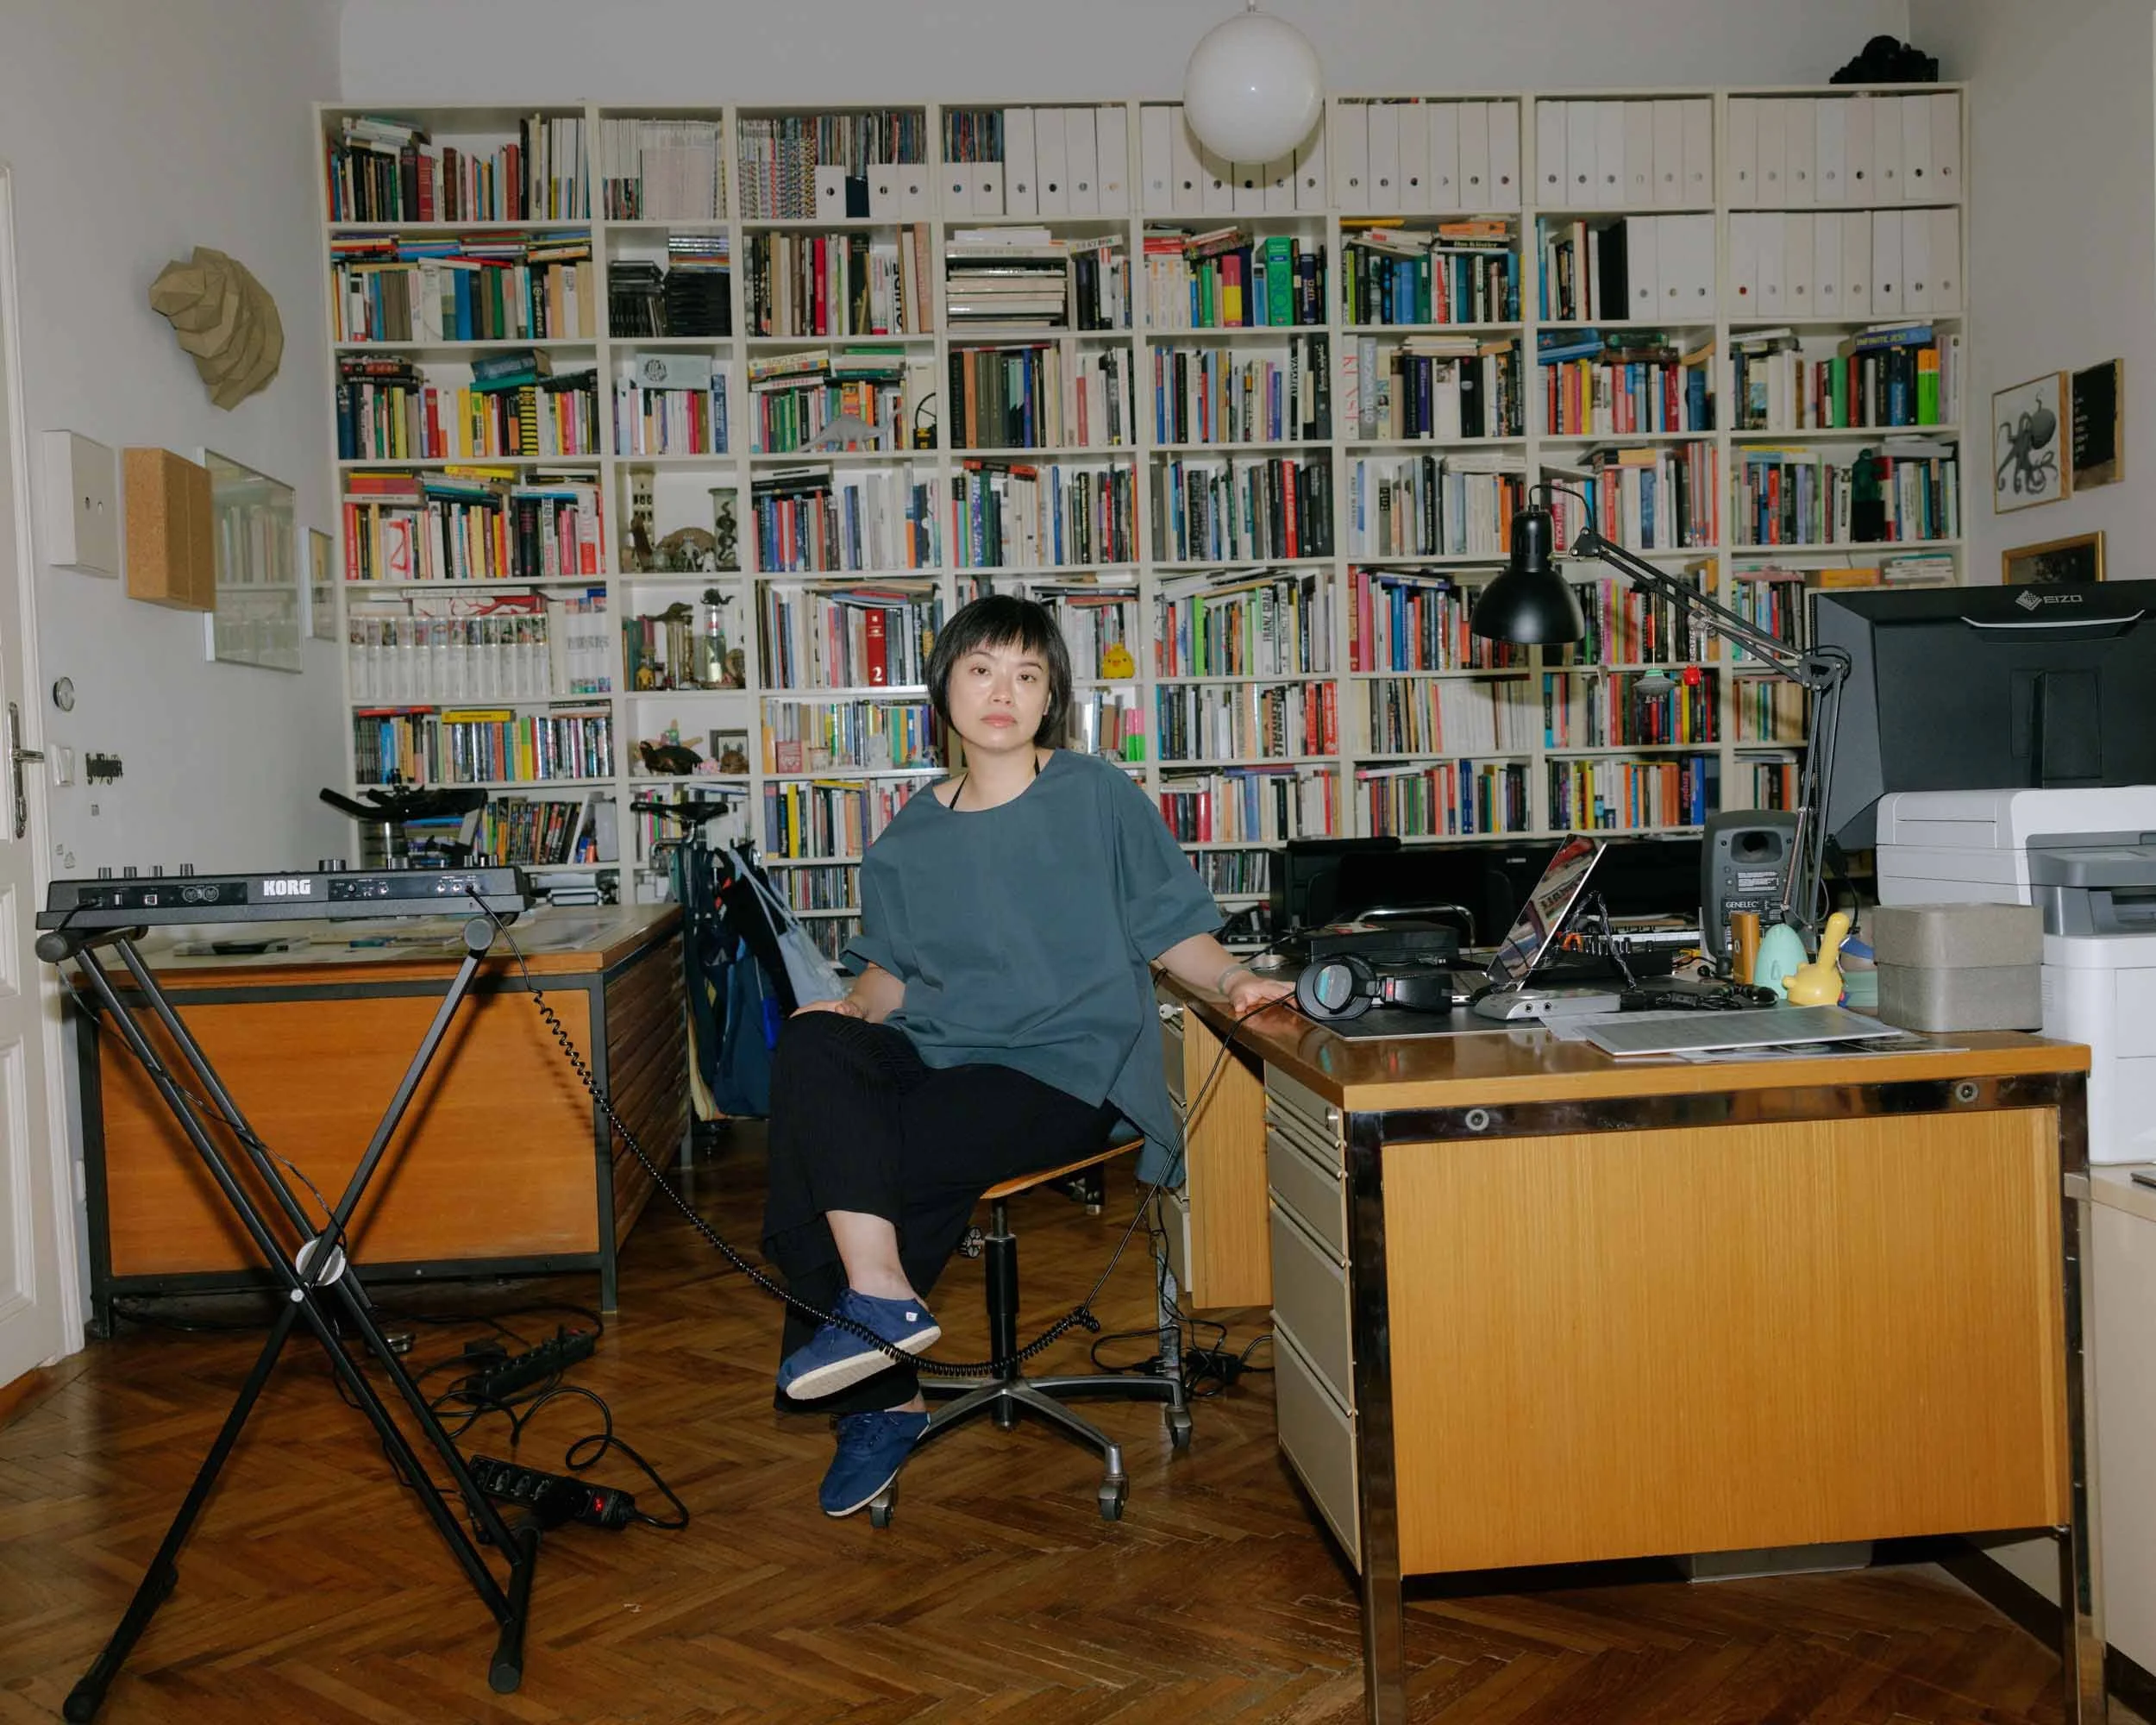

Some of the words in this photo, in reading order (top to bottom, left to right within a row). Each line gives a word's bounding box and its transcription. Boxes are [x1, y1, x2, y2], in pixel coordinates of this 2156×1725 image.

[1364, 343, 1375, 393] WAGNER
[1364, 396, 1375, 423] OTTO
[1263, 589, 1273, 612] GRAF
[2043, 594, 2083, 605] EIZO
[1263, 615, 1273, 643] FRANZ
[873, 667, 882, 682] 2
[1681, 771, 1690, 808] Empire
[263, 879, 311, 896] KORG
[1726, 900, 1758, 909] GENELEC
